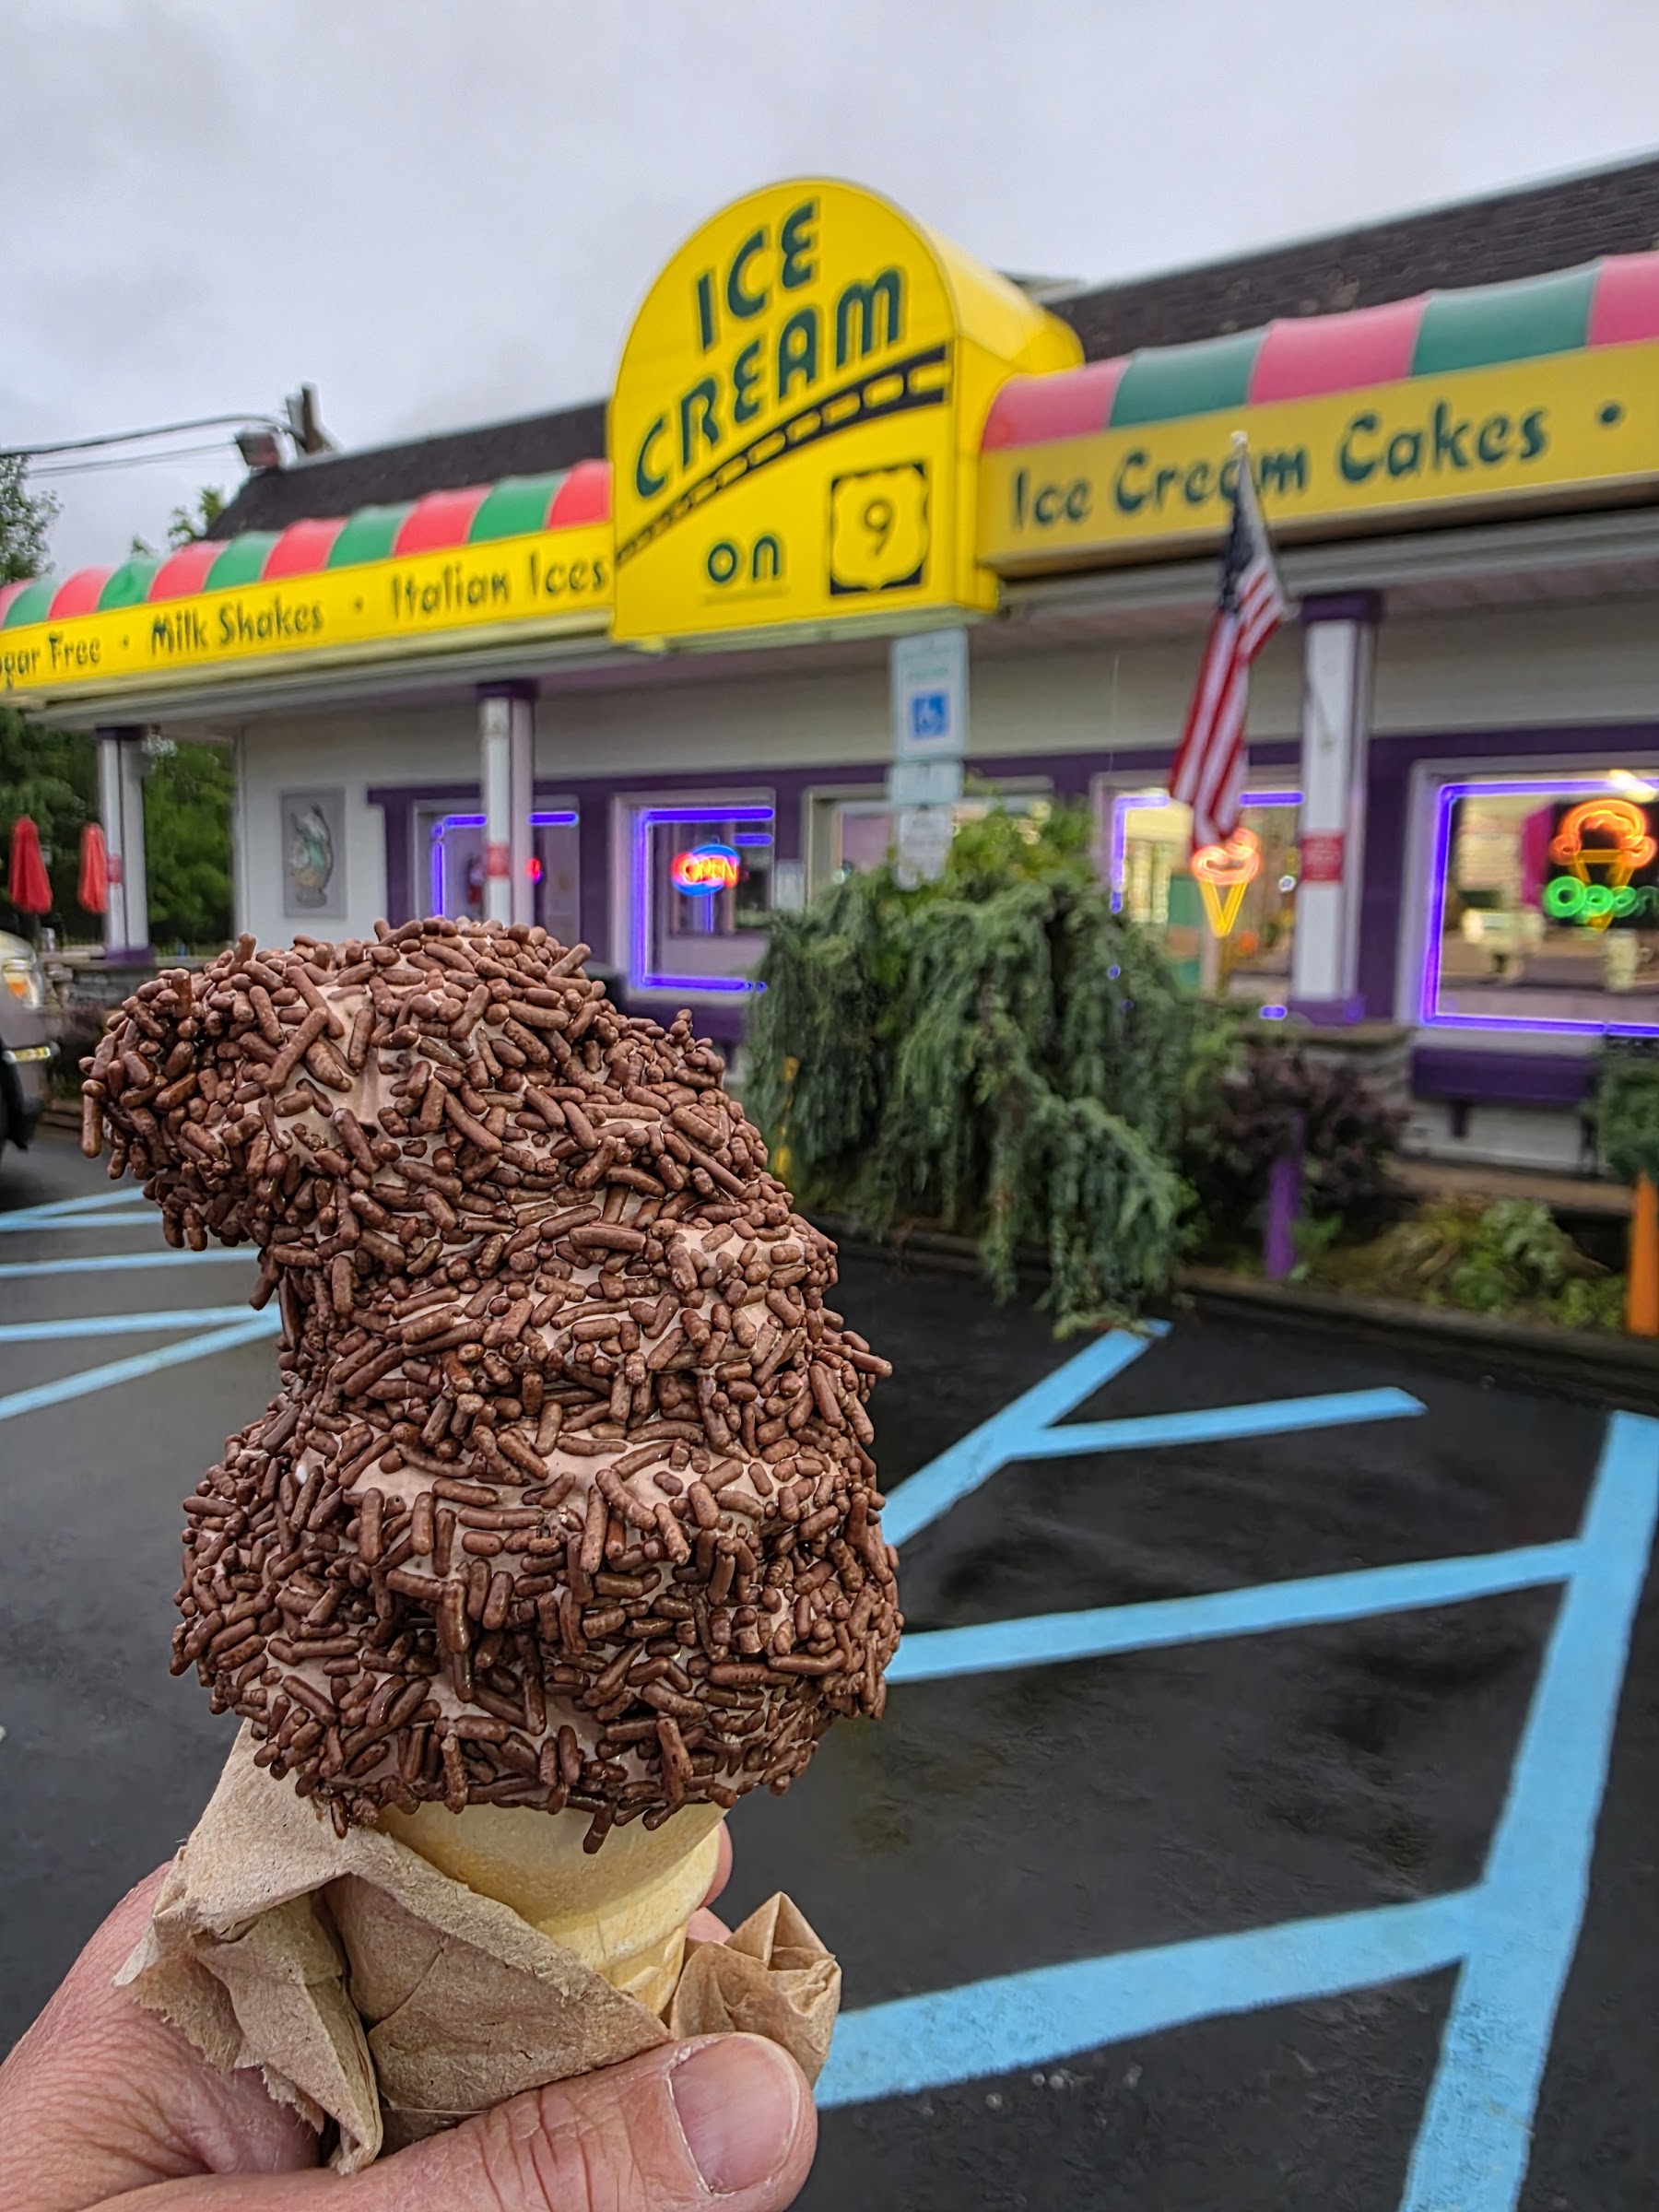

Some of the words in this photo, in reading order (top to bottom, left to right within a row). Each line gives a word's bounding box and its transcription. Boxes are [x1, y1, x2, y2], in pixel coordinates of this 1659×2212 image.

[698, 200, 817, 352] ICE
[636, 267, 901, 499] CREAM
[1015, 469, 1089, 531] Ice
[1115, 449, 1307, 512] Cream
[1341, 402, 1548, 482] Cakes
[707, 535, 780, 584] on
[865, 500, 894, 557] 9
[0, 647, 41, 691] gar
[49, 631, 100, 671] Free
[151, 607, 207, 655] Milk
[219, 594, 323, 645] Shakes
[392, 562, 509, 619] Italian
[530, 553, 608, 596] Ices
